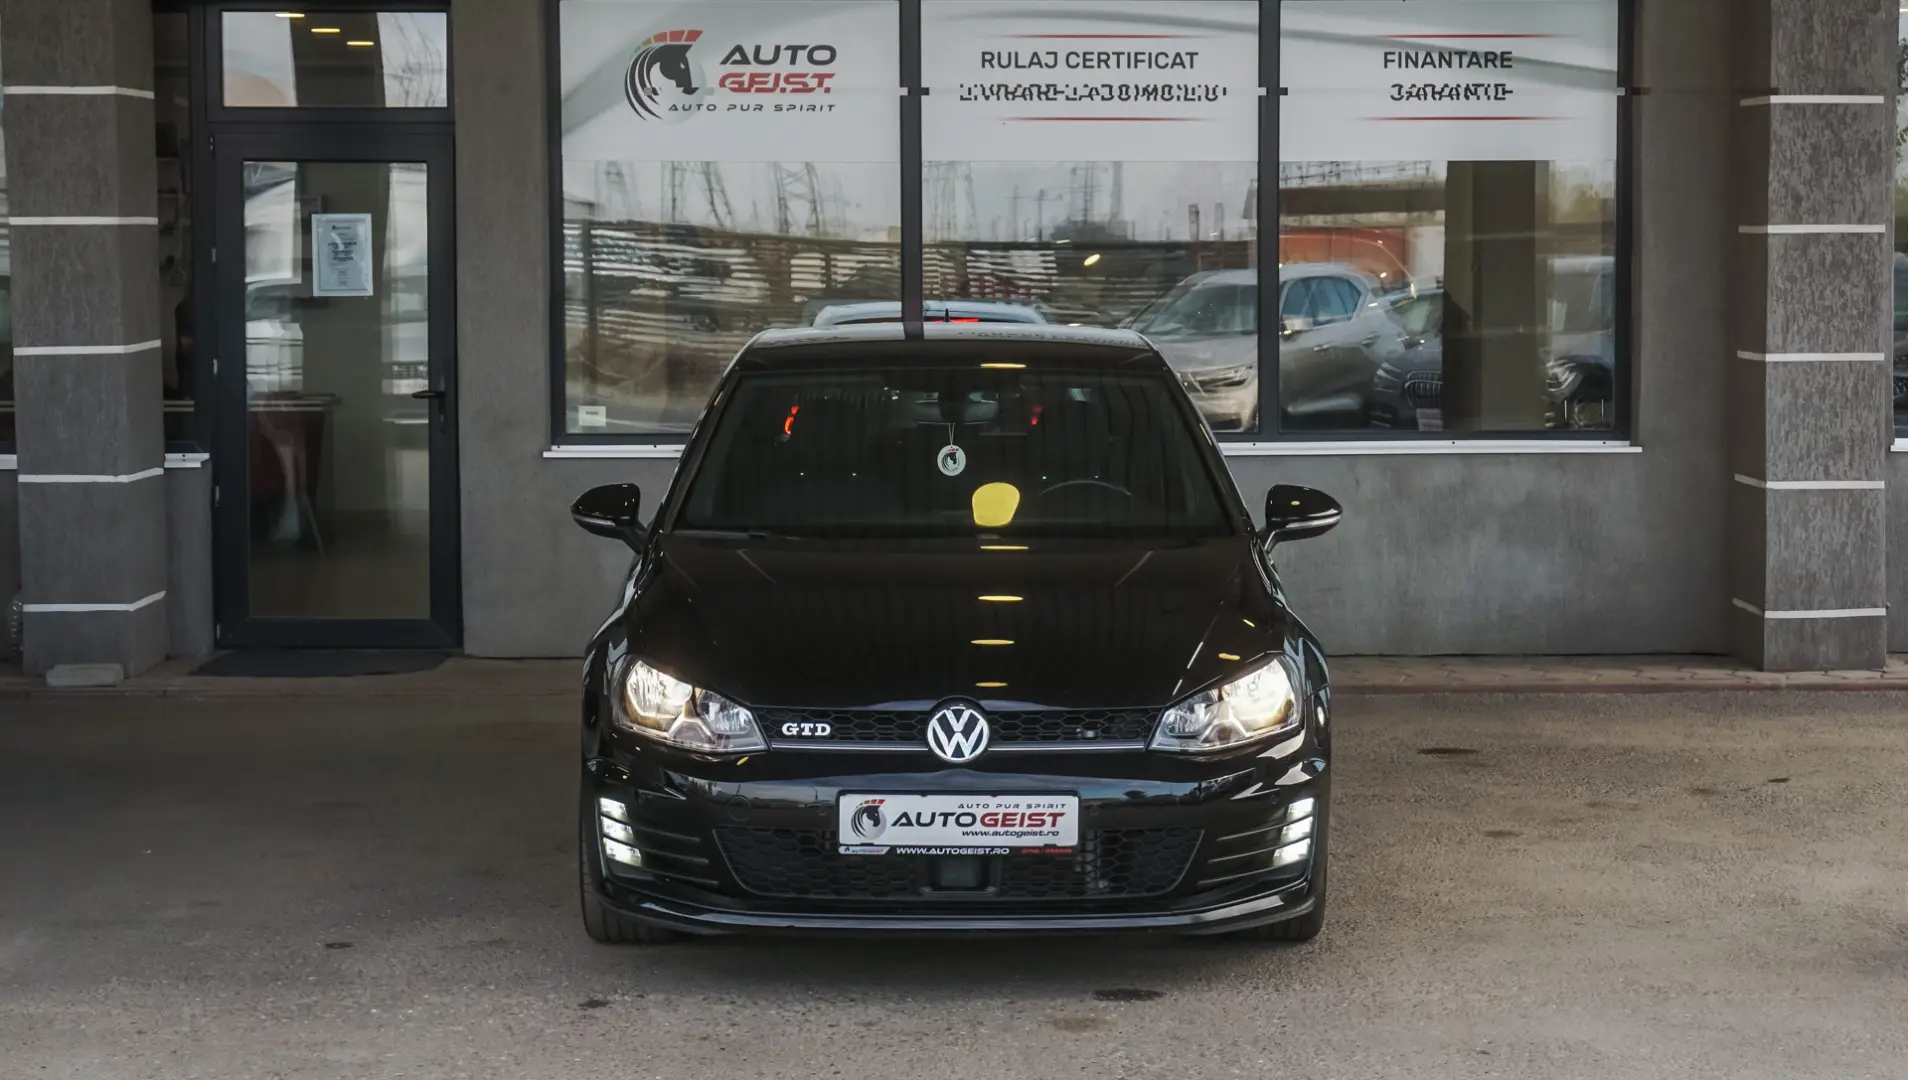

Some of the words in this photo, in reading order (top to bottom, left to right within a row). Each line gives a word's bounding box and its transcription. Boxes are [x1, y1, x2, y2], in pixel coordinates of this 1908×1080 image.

[719, 44, 837, 66] AUTO
[981, 50, 1059, 70] RULAJ
[1065, 50, 1199, 70] CERTIFICAT
[1383, 50, 1513, 69] FINANTARE
[718, 72, 836, 94] GEIST
[668, 103, 717, 112] AUTO
[726, 103, 763, 112] PUR
[773, 103, 836, 112] SPIRIT
[781, 722, 831, 737] GTD
[890, 811, 1067, 828] AUTOGEIST
[961, 829, 1060, 839] www.autogeist.ro
[896, 847, 1010, 855] WWW.AUTOGEIST.RO
